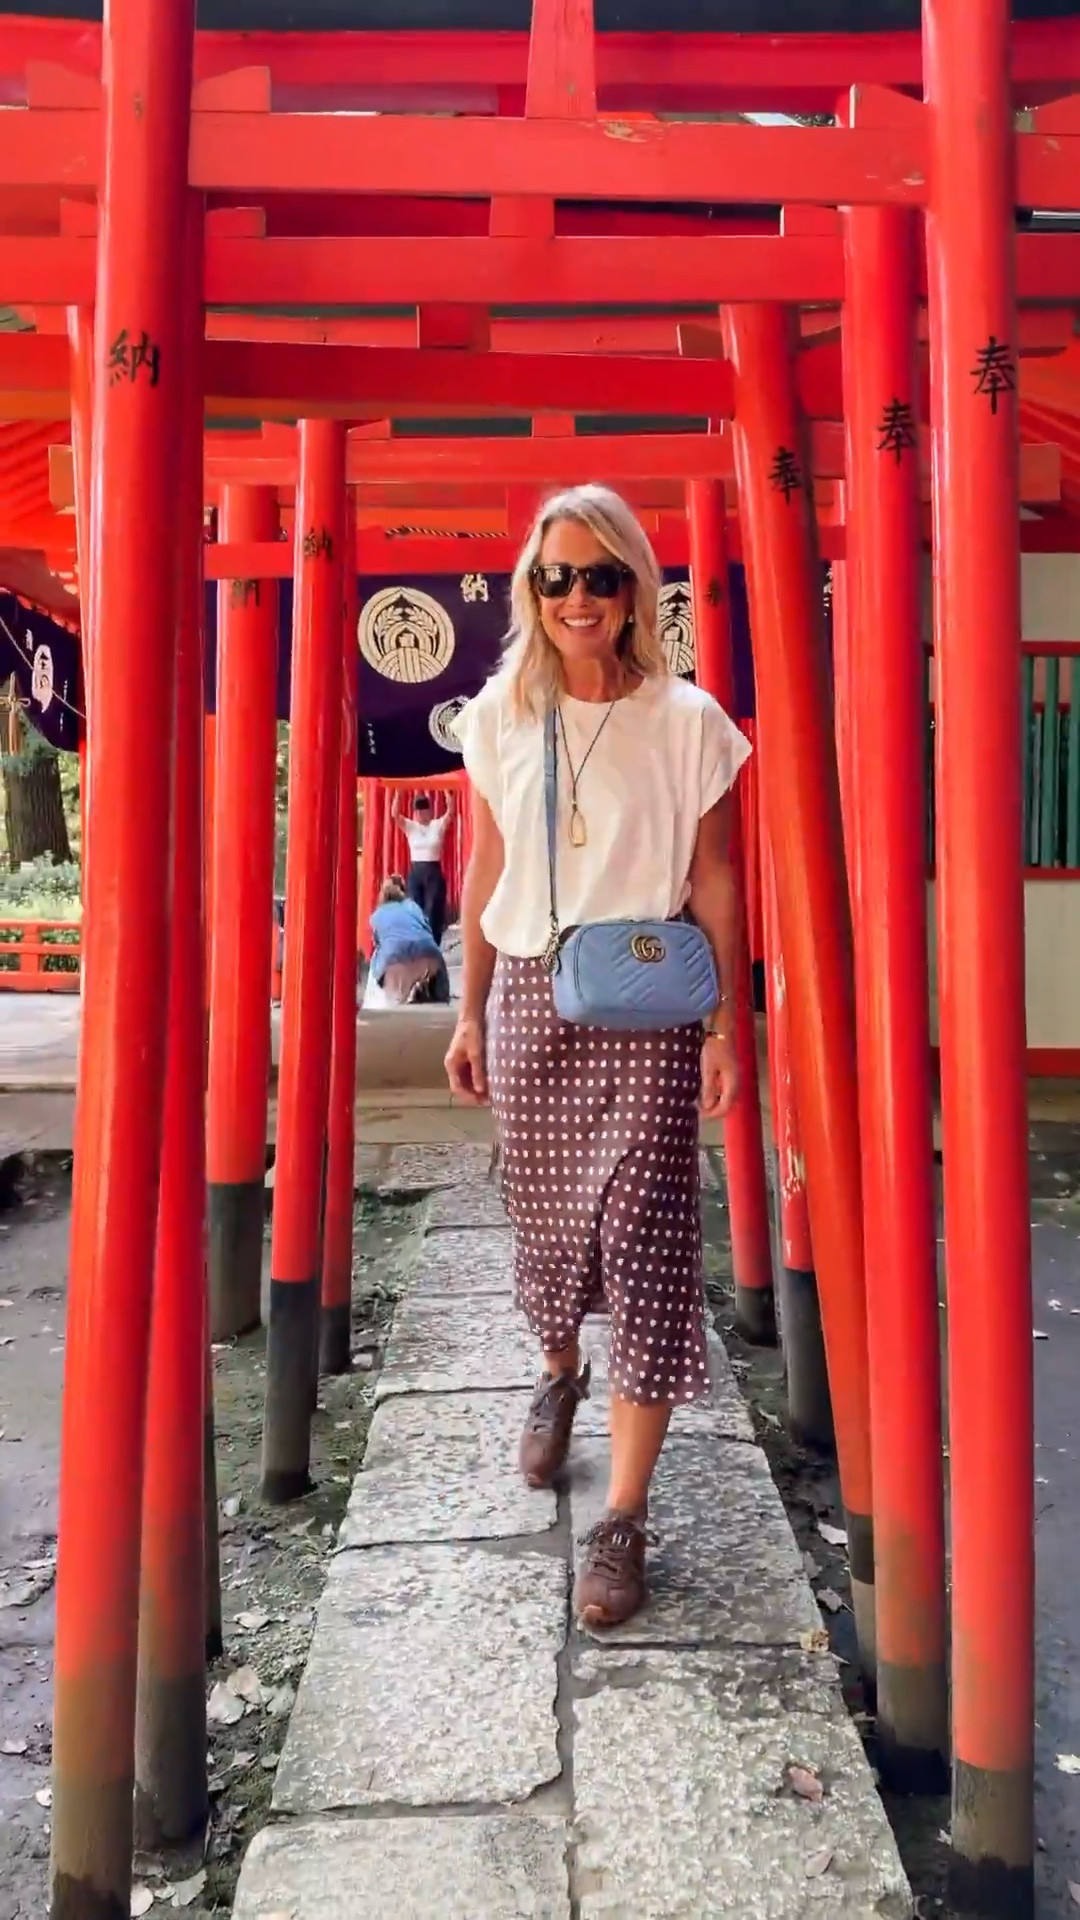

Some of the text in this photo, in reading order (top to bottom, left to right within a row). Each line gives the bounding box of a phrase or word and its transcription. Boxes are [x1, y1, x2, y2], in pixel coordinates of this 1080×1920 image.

[108, 329, 160, 388] 納
[970, 336, 1015, 414] 奉
[877, 399, 915, 464] 奉
[768, 447, 802, 505] 奉
